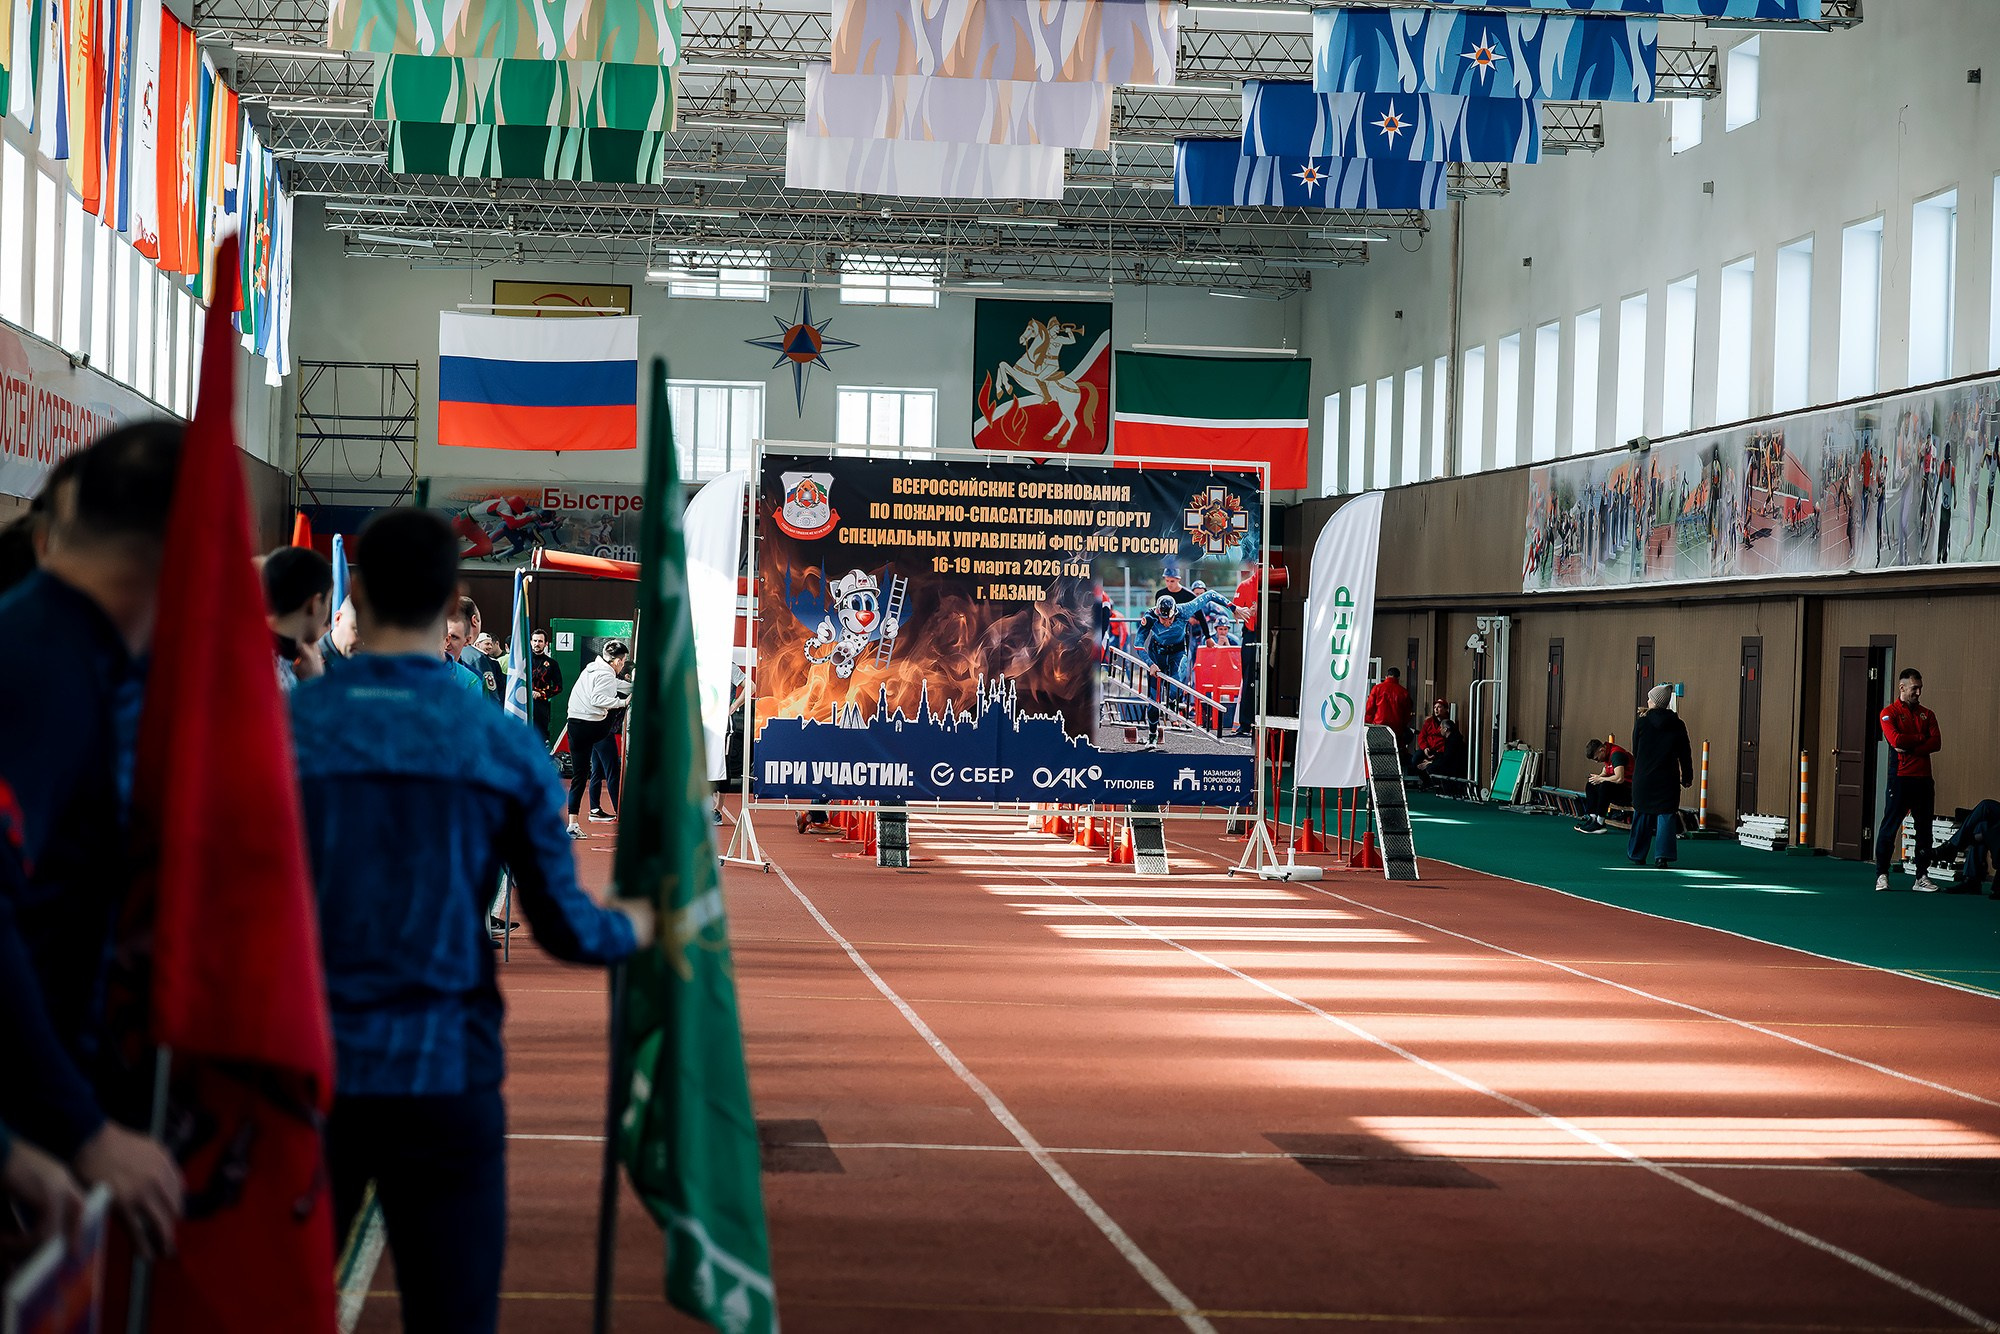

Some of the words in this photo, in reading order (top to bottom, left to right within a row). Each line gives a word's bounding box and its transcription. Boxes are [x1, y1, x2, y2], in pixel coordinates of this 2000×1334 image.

[892, 477, 1015, 498] ВСЕРОССИЙСКИЕ
[1018, 482, 1131, 502] СОРЕВНОВАНИЯ
[870, 502, 890, 520] ПО
[893, 503, 1094, 526] ПОЖАРНО-СПАСАТЕЛЬНОМУ
[1096, 510, 1151, 528] СПОРТУ
[838, 526, 950, 547] СПЕЦИАЛЬНЫХ
[953, 530, 1046, 550] УПРАВЛЕНИЙ
[1049, 534, 1083, 551] ФПС
[1086, 535, 1119, 553] МЧС
[1121, 536, 1179, 554] РОССИИ
[931, 556, 971, 574] 16-19
[973, 560, 1021, 576] марта
[1023, 559, 1061, 577] 2026
[1063, 563, 1091, 580] год
[976, 585, 987, 600] г.
[989, 584, 1047, 601] КАЗАНЬ
[559, 633, 570, 648] 4
[1330, 585, 1355, 681] СБЕР
[764, 760, 807, 784] ПРИ
[811, 761, 914, 786] УЧАСТИИ:
[959, 767, 1014, 783] СБЕР
[1203, 769, 1242, 777] КАЗАНСКИЙ
[1203, 776, 1242, 784] ПОРОХОВОЙ
[1103, 779, 1155, 790] ТУПОЛЕВ
